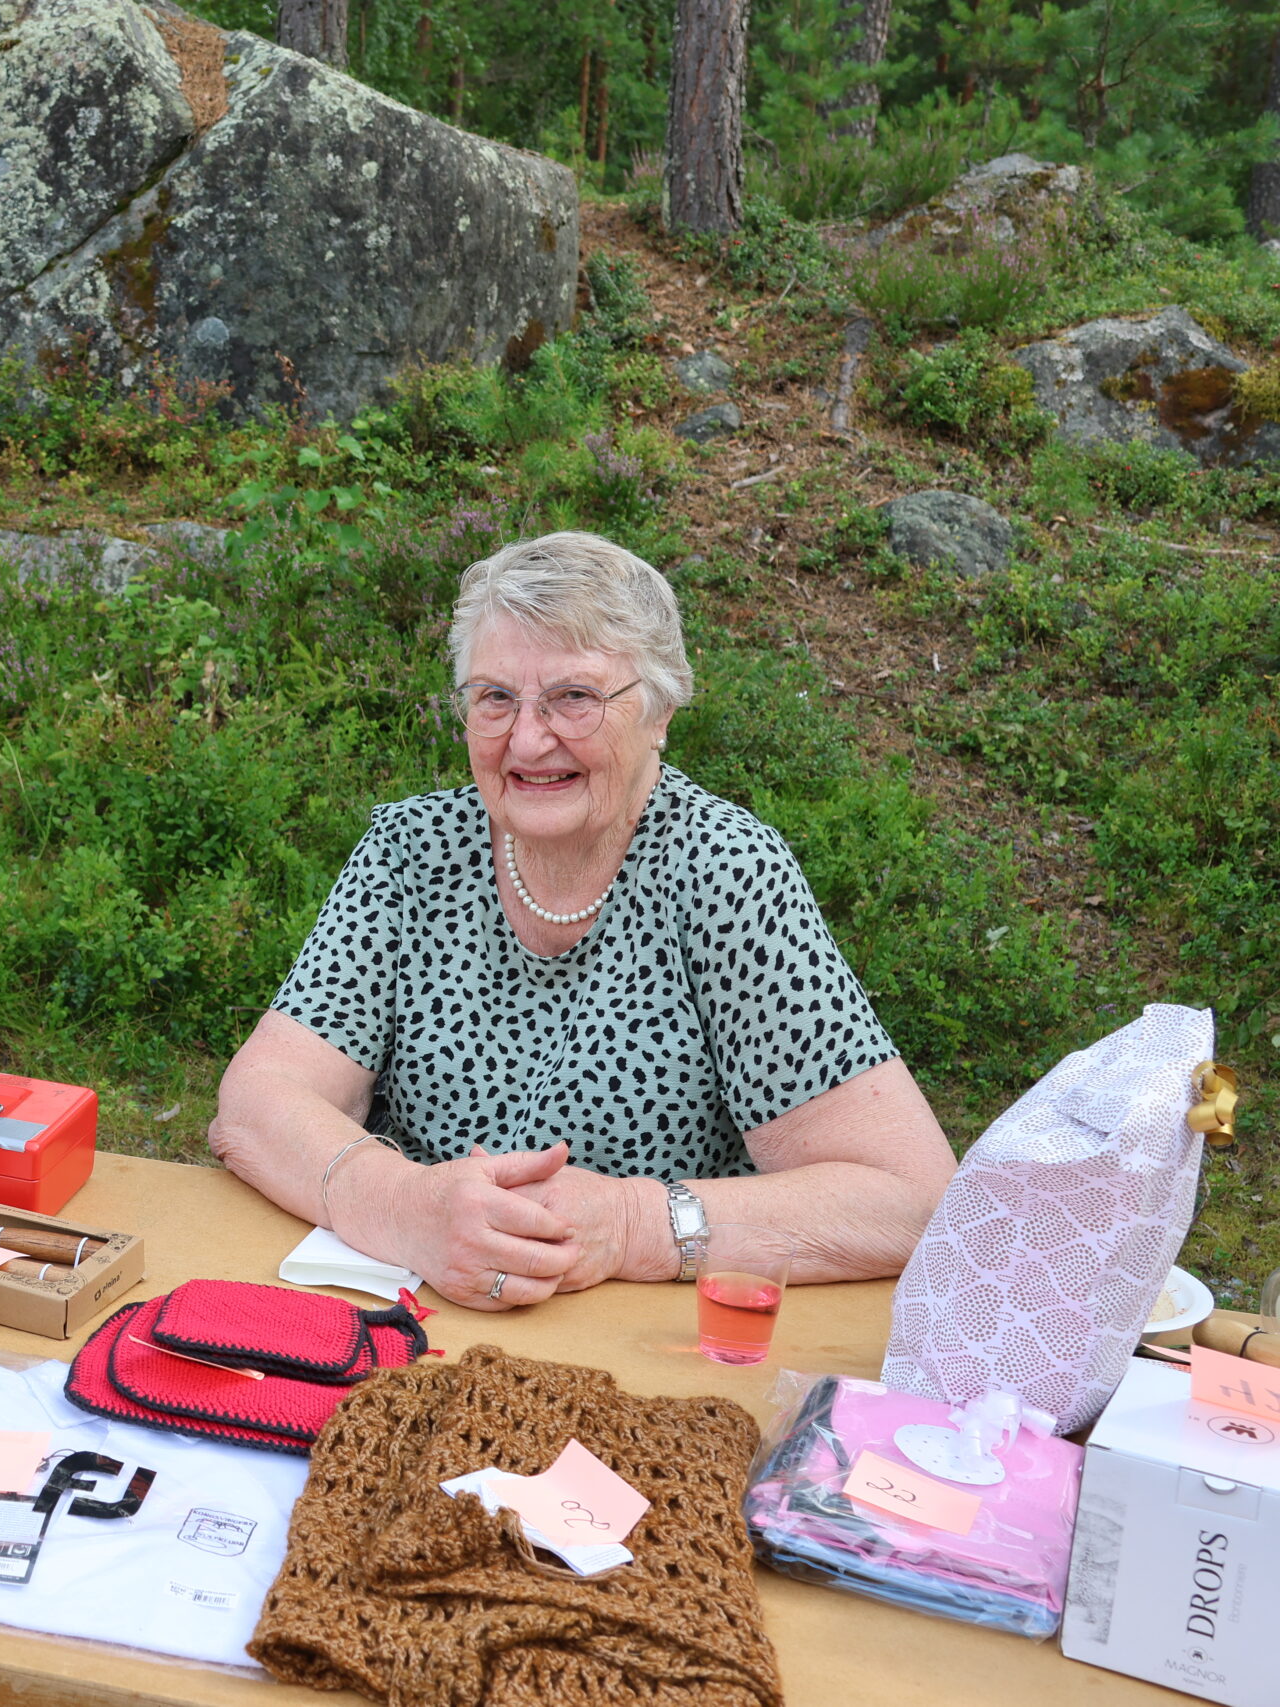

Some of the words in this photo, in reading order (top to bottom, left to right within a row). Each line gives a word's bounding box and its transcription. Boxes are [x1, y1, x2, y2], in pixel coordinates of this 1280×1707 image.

[866, 1476, 925, 1510] 22
[1186, 1529, 1229, 1640] DROPS
[1164, 1658, 1227, 1686] MAGNOR
